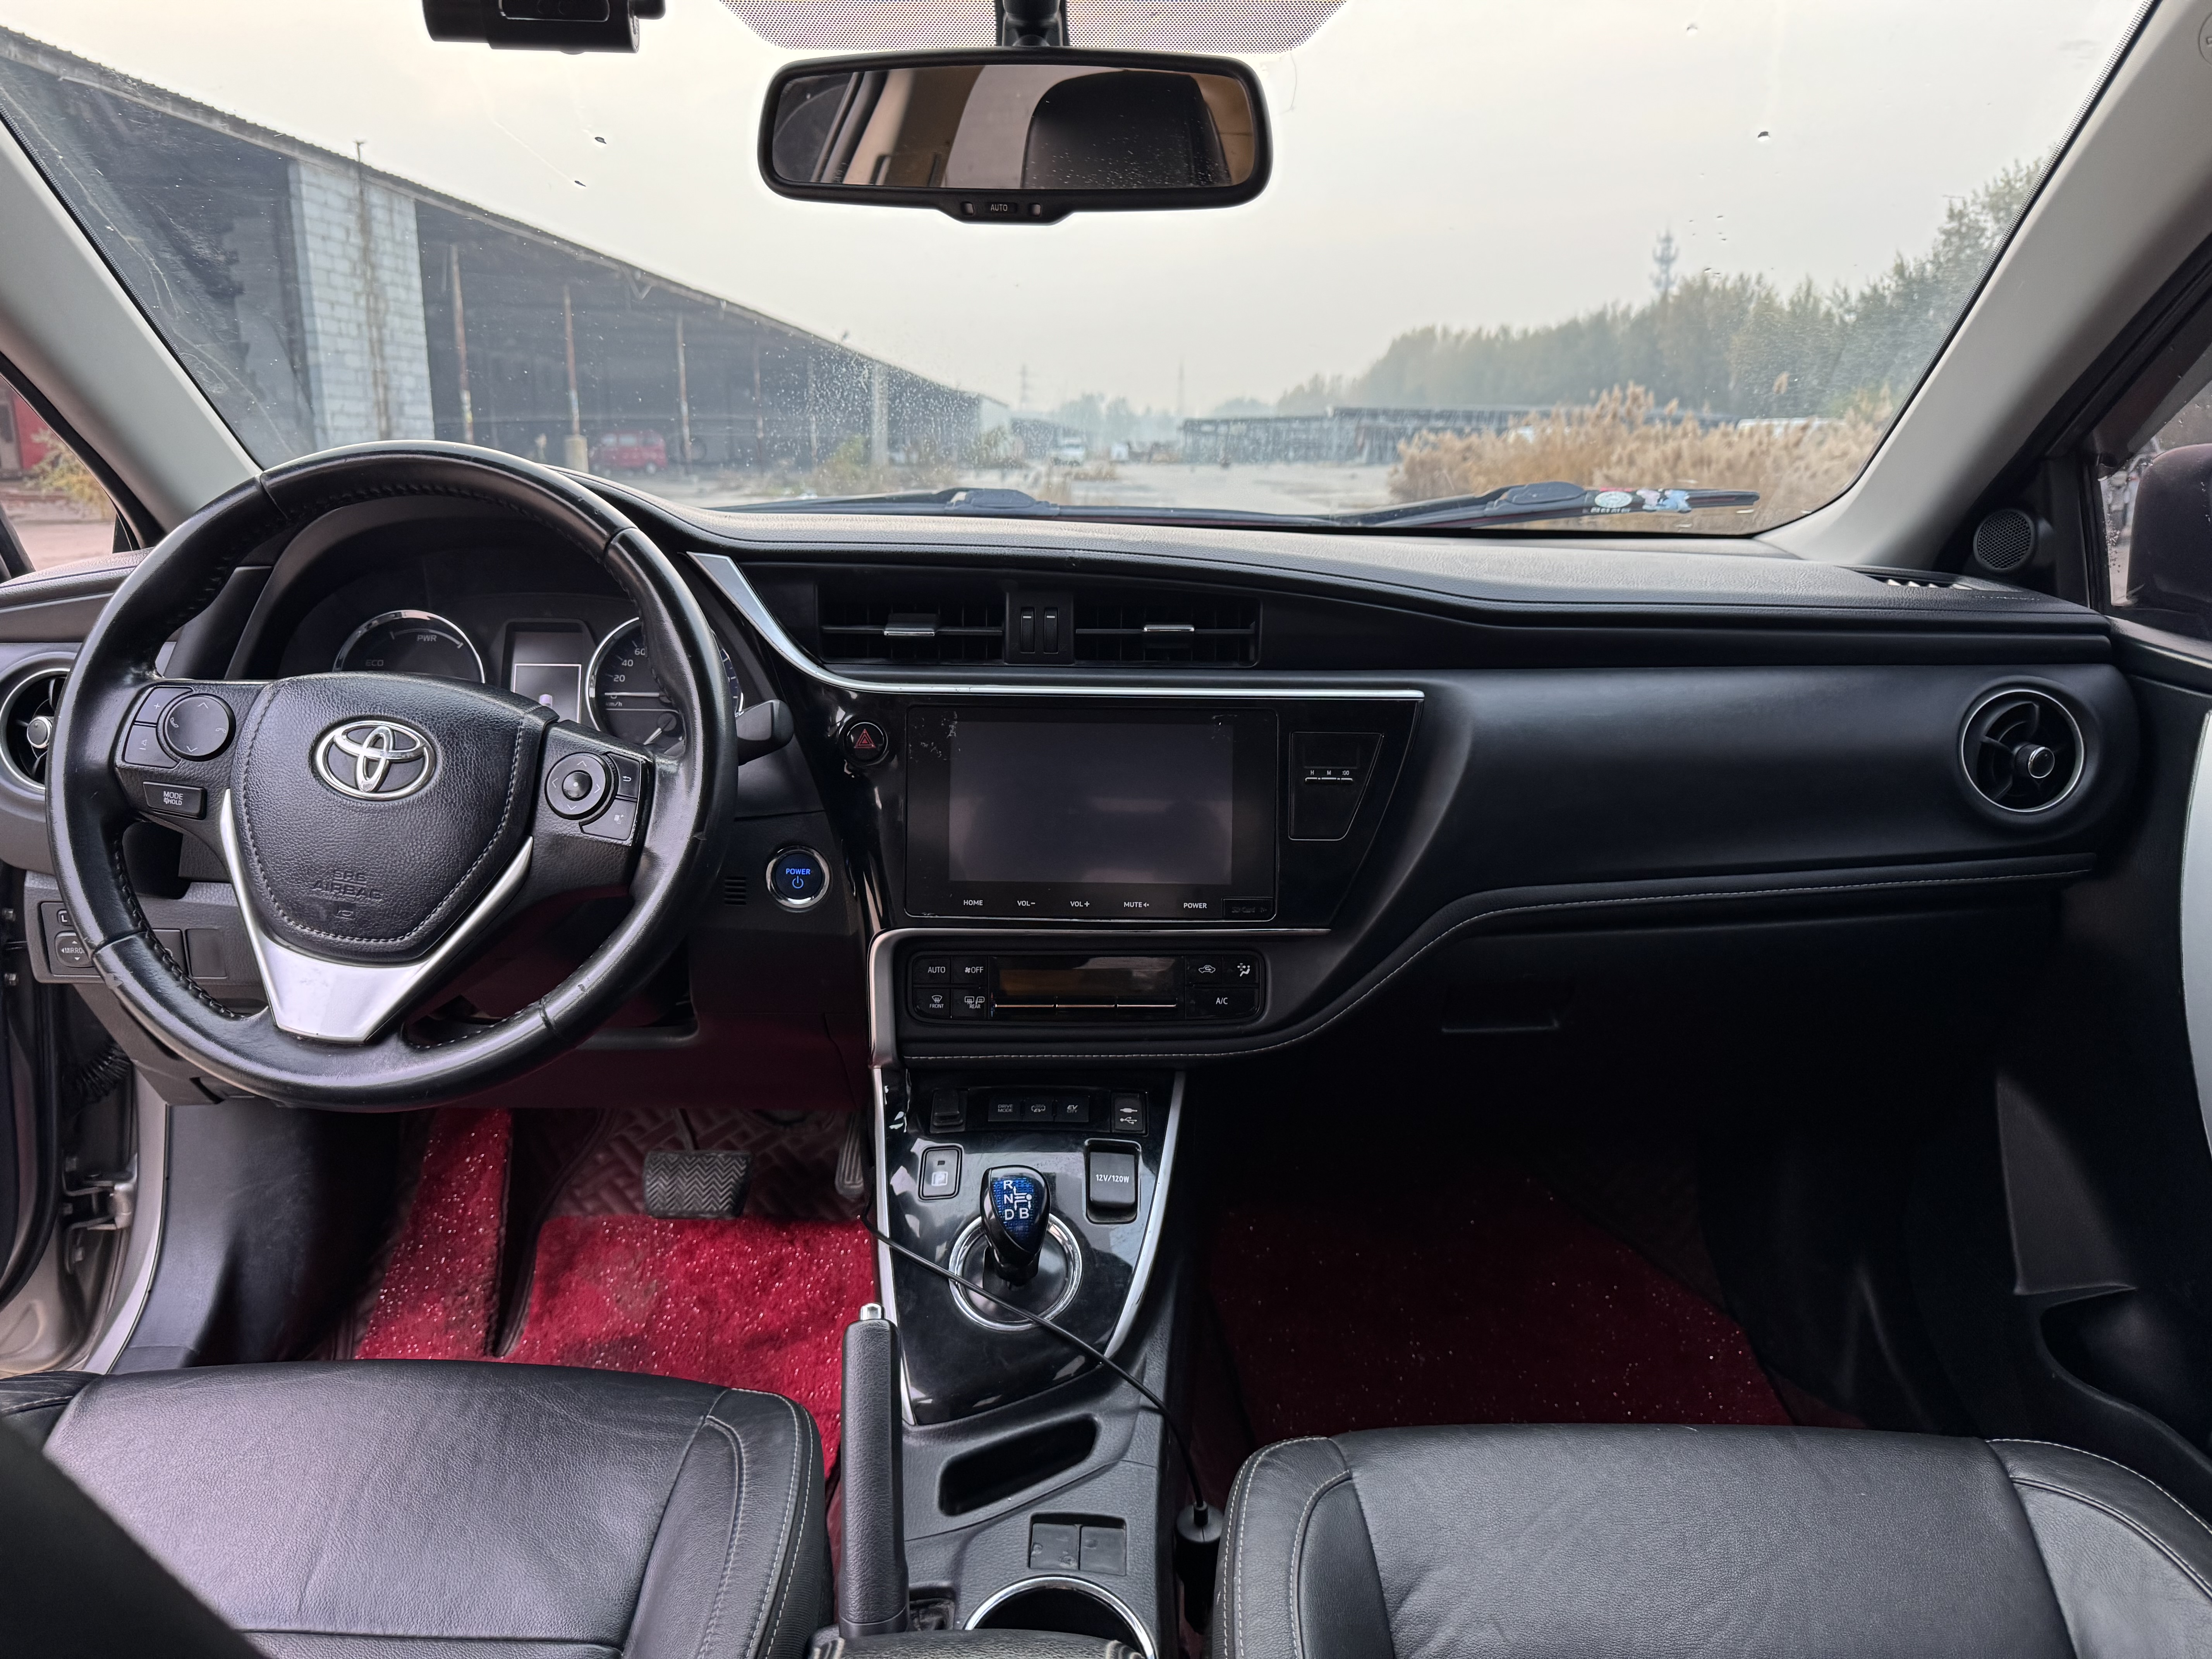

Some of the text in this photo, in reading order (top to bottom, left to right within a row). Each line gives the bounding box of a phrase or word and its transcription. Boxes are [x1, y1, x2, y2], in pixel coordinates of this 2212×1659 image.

[163, 791, 183, 800] MODE
[311, 881, 383, 901] AIRBAG
[1096, 1174, 1129, 1183] 12V/120W
[1003, 1180, 1013, 1190] R
[1004, 1194, 1013, 1204] N
[1005, 1207, 1029, 1220] D B
